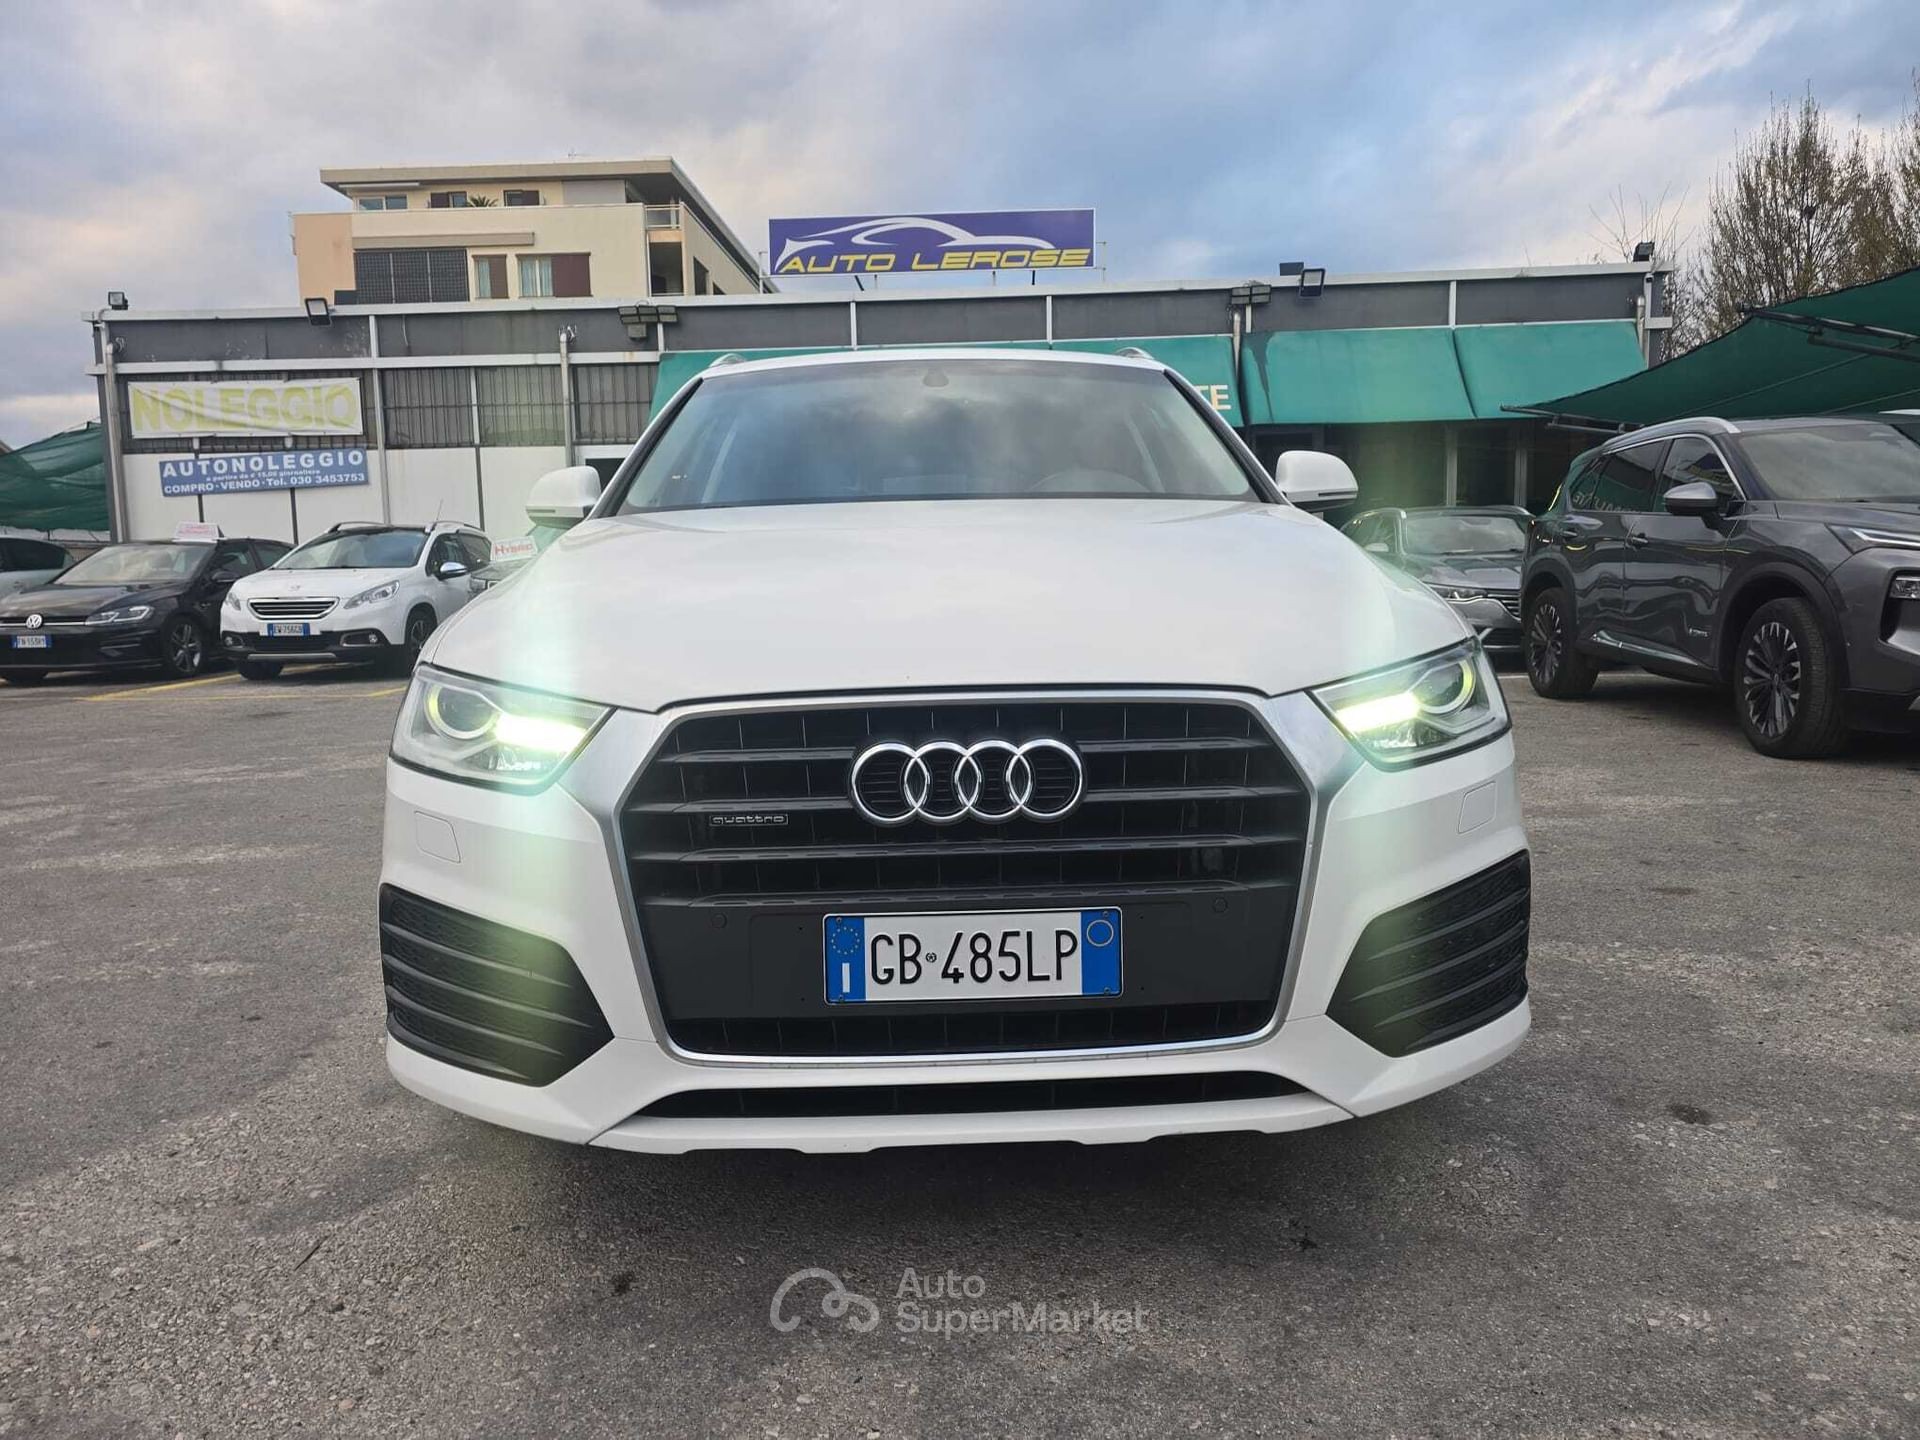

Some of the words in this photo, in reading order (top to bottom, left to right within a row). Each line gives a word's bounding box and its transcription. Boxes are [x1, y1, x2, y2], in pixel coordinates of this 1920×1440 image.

[778, 253, 896, 274] AUTO
[911, 248, 1091, 270] LEROSE
[133, 385, 357, 431] NOLEGGIO
[162, 450, 363, 478] AUTONOLEGGIO
[164, 482, 214, 494] COMPRO
[220, 478, 260, 490] VENDO
[290, 475, 312, 485] 030
[712, 815, 785, 825] quattro
[870, 933, 922, 985] GB
[941, 929, 1078, 984] 485LP
